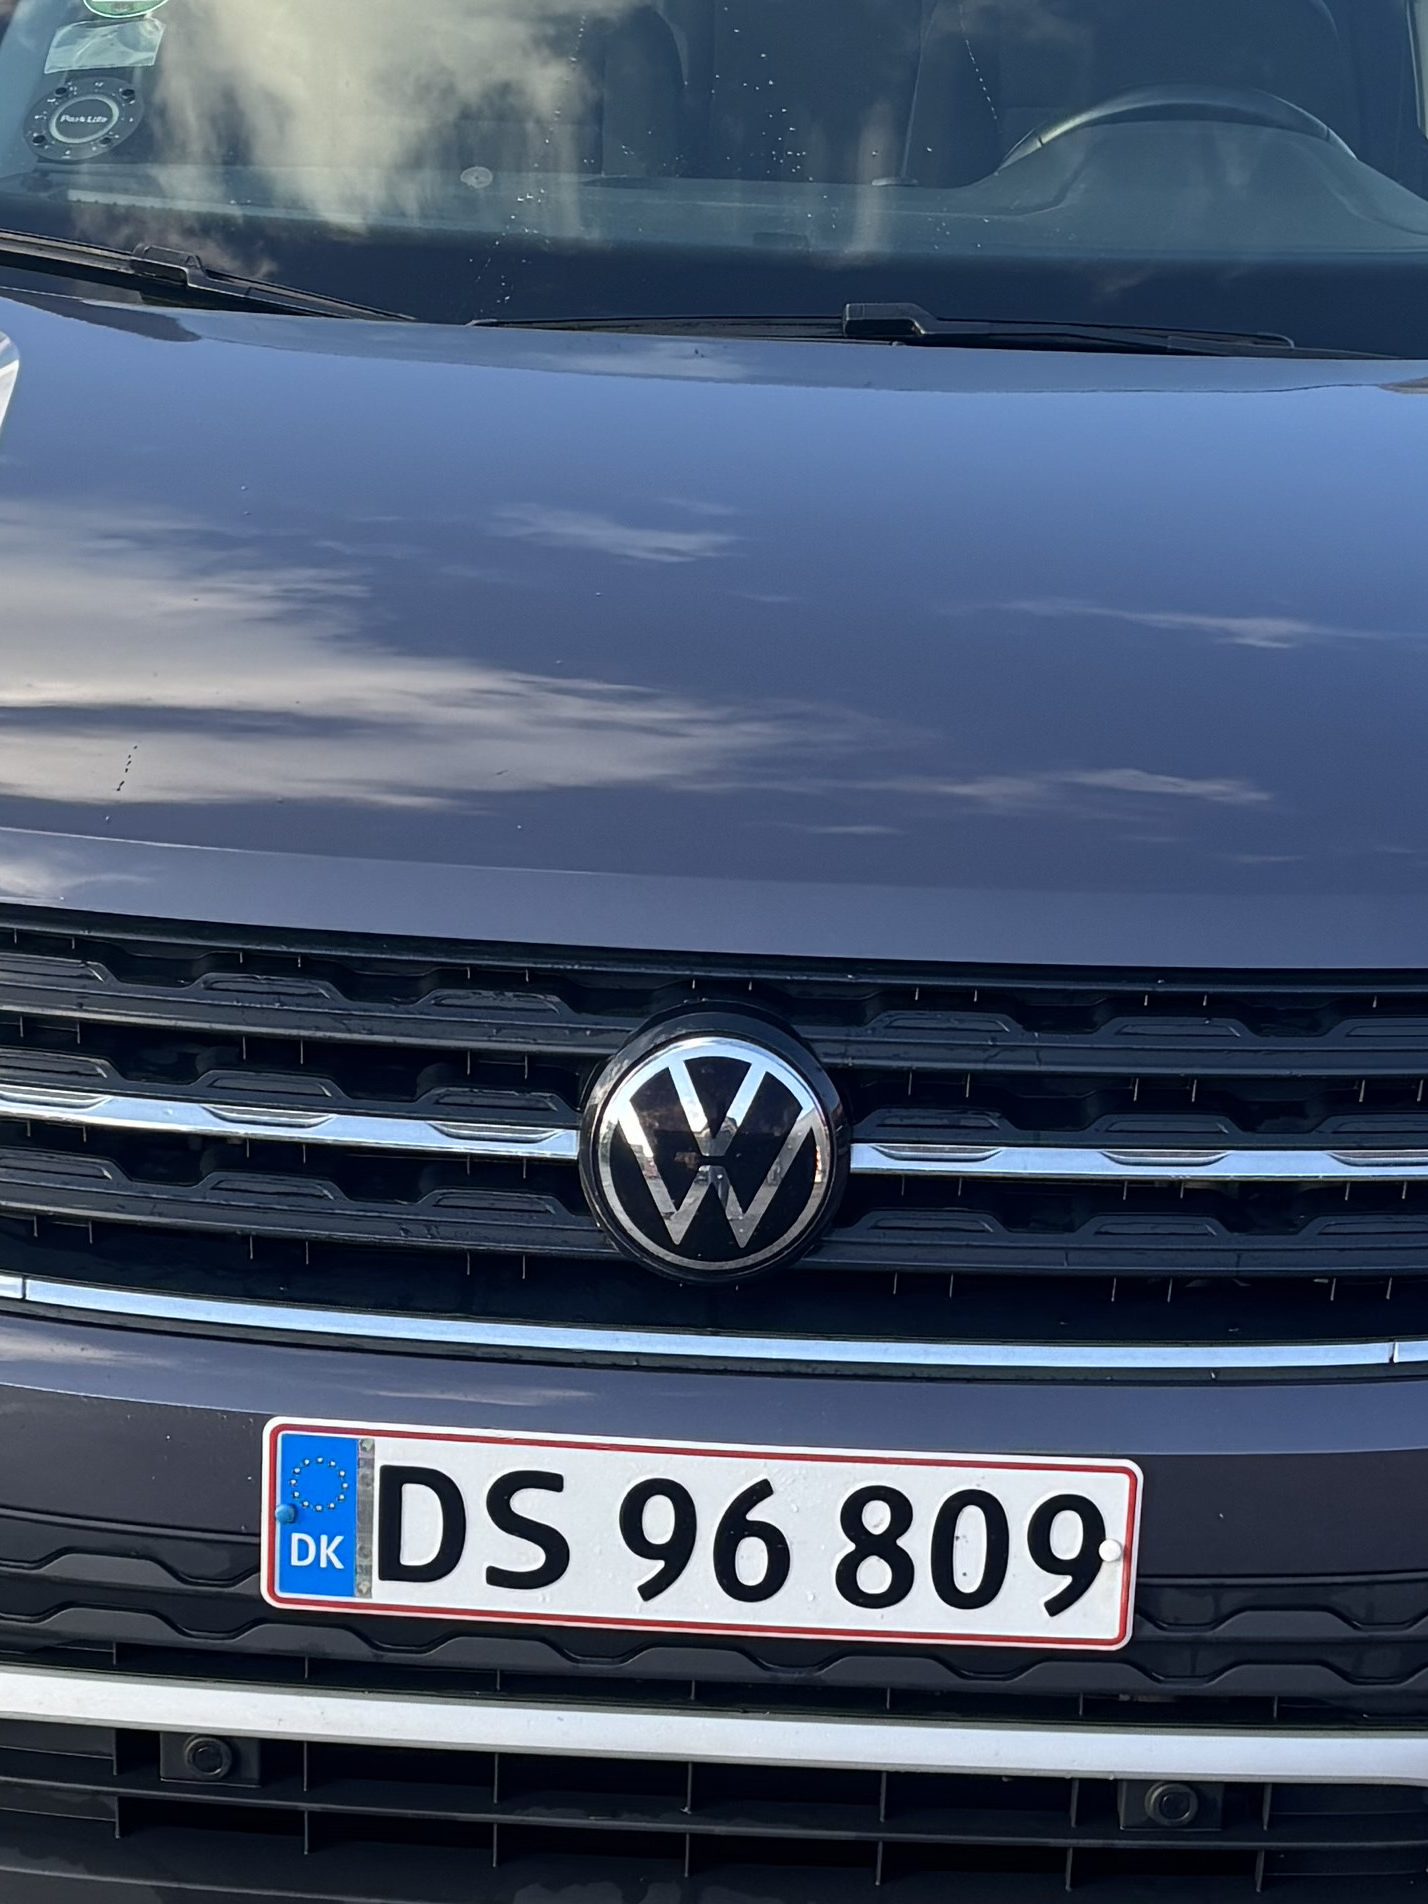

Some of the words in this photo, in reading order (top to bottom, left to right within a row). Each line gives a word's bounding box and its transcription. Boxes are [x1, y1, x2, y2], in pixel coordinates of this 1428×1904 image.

[612, 1049, 820, 1249] VW
[289, 1532, 344, 1569] DK
[378, 1464, 571, 1590] DS
[619, 1477, 792, 1603] 96
[835, 1485, 1107, 1618] 809
